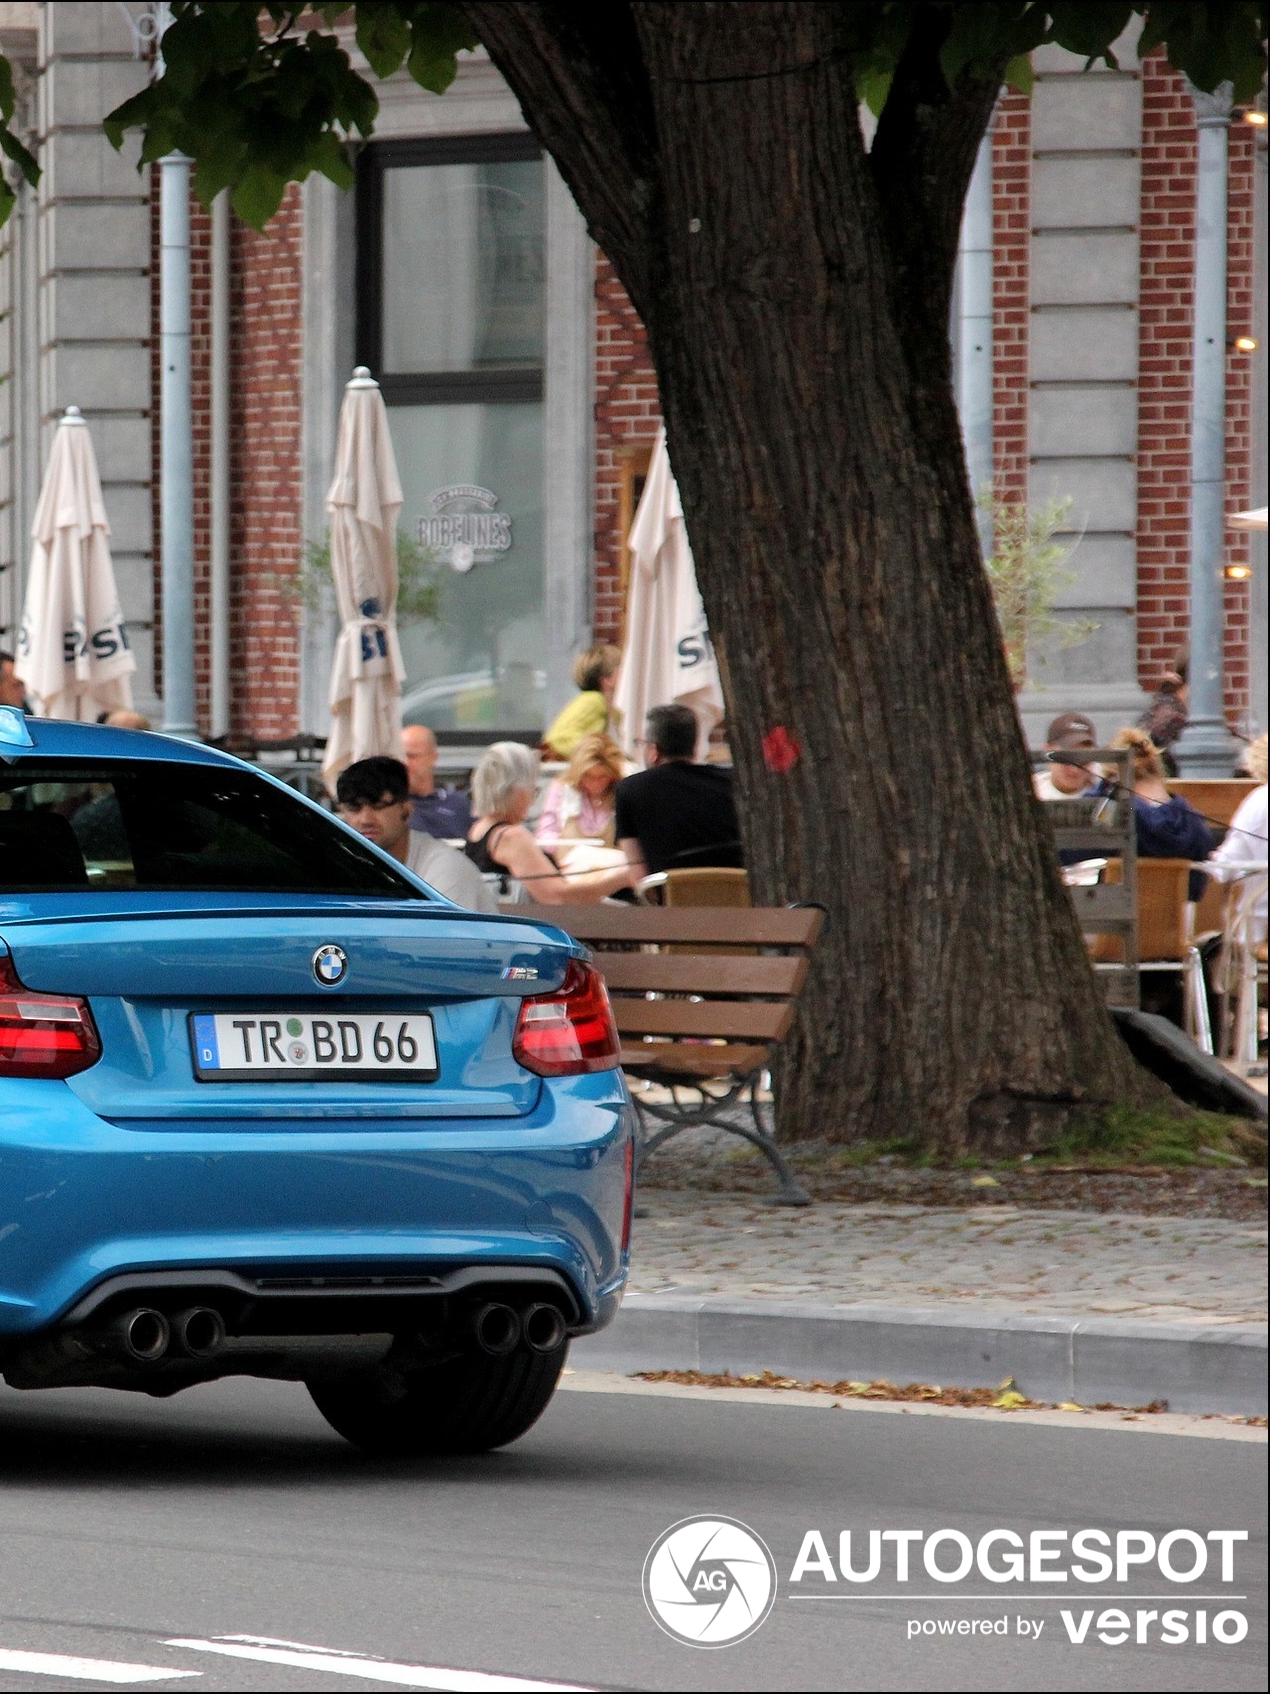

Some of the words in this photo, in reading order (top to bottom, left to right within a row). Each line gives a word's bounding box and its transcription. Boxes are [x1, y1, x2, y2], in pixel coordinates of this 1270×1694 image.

[203, 1049, 213, 1061] D
[233, 1020, 287, 1062] TR
[311, 1020, 364, 1063] BD
[373, 1021, 419, 1063] 66
